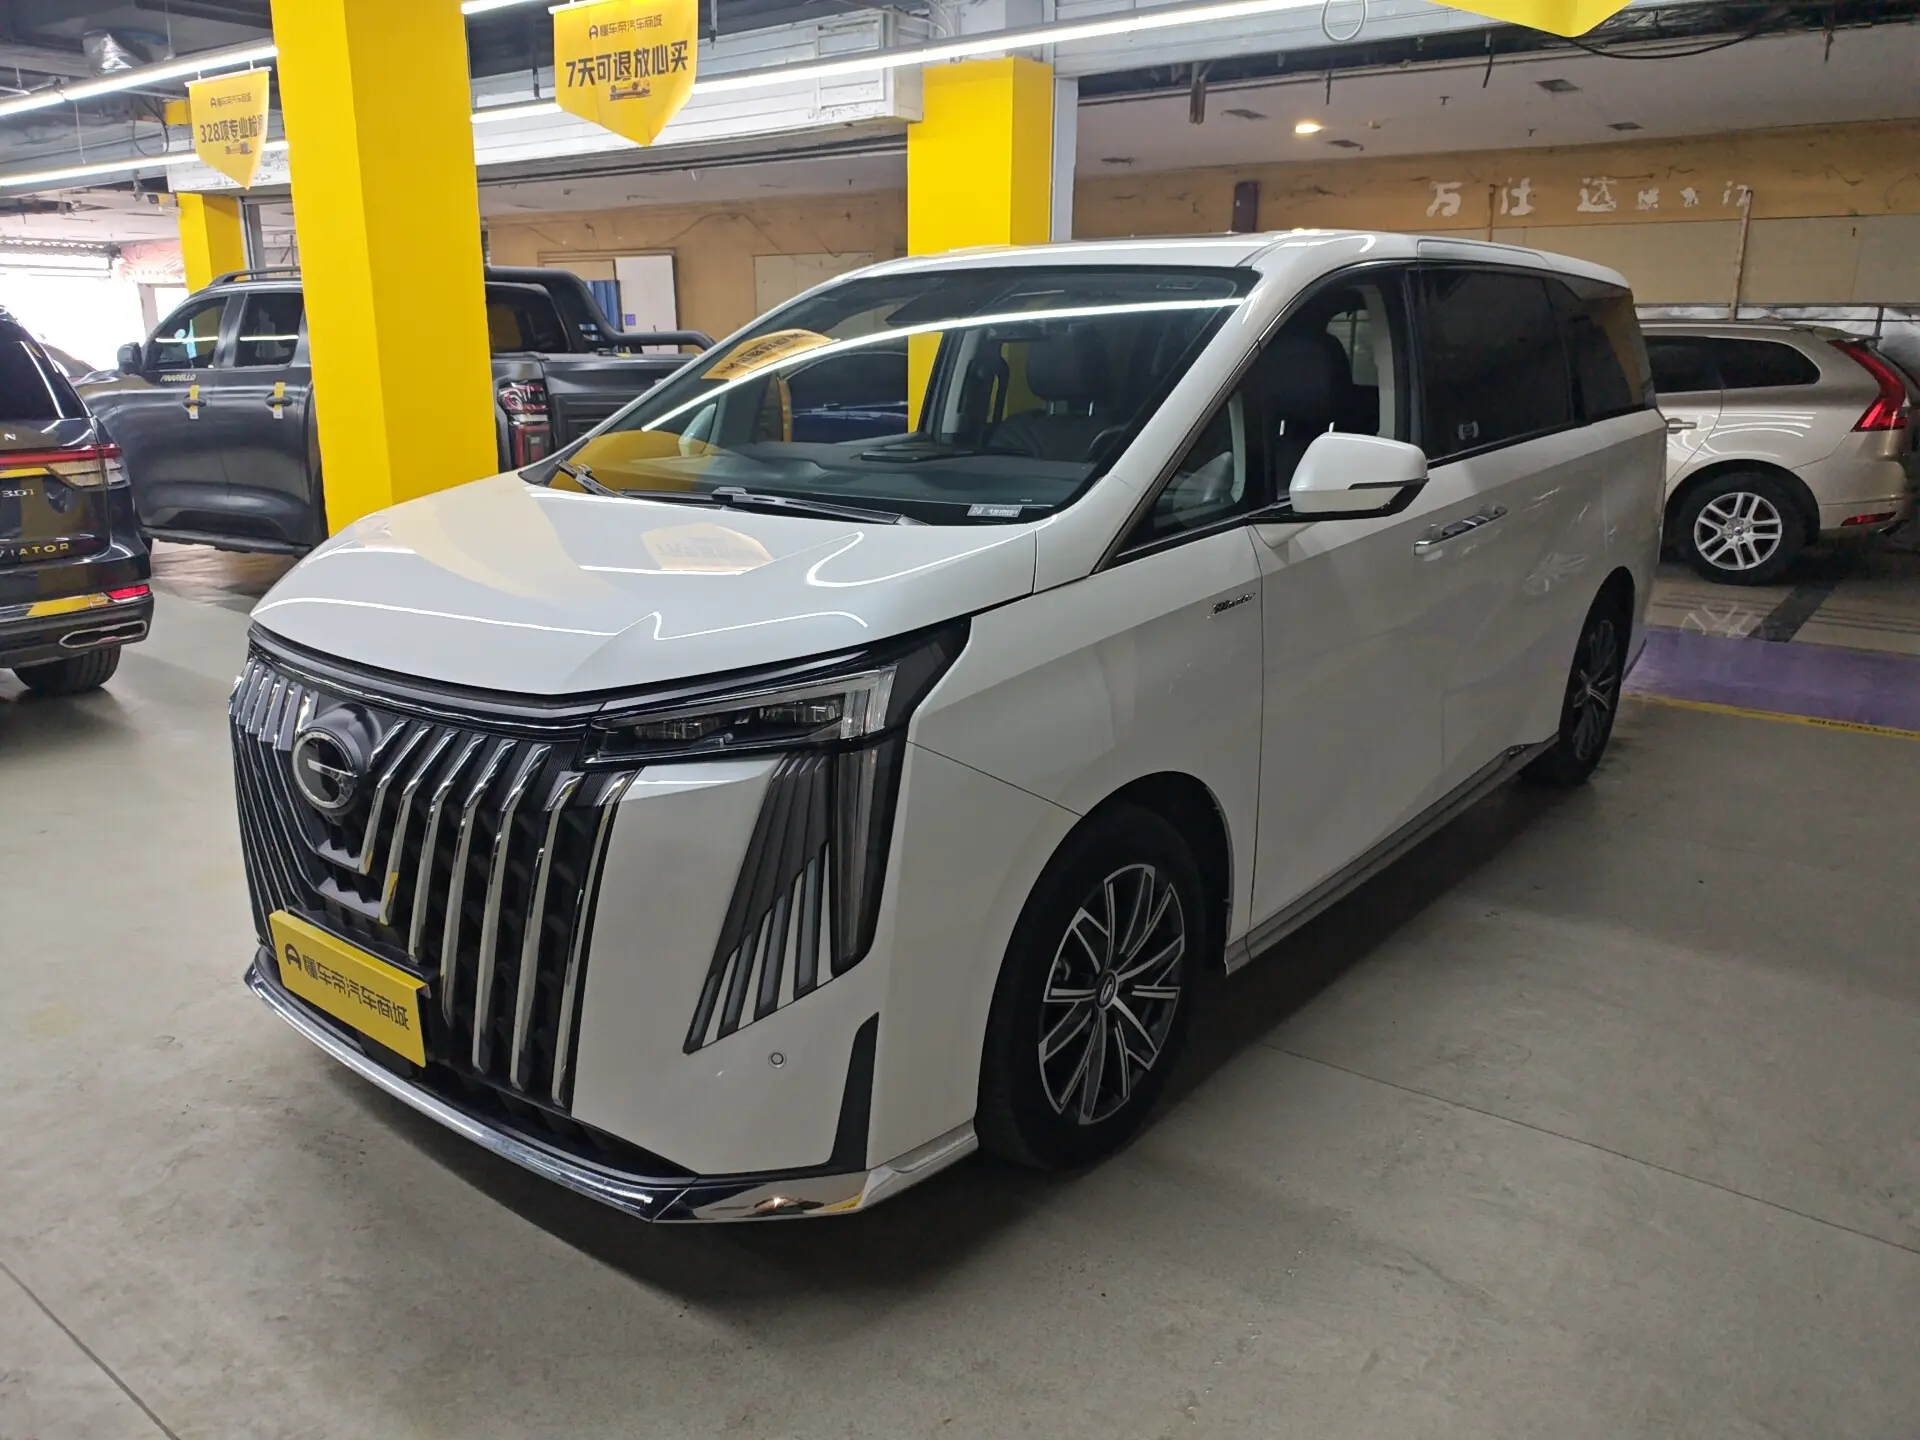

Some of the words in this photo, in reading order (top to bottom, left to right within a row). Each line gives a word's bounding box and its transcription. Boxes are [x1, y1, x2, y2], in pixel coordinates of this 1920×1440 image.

[566, 40, 688, 87] 7天可退放心买
[303, 954, 410, 1031] 懂车帝汽车商城
